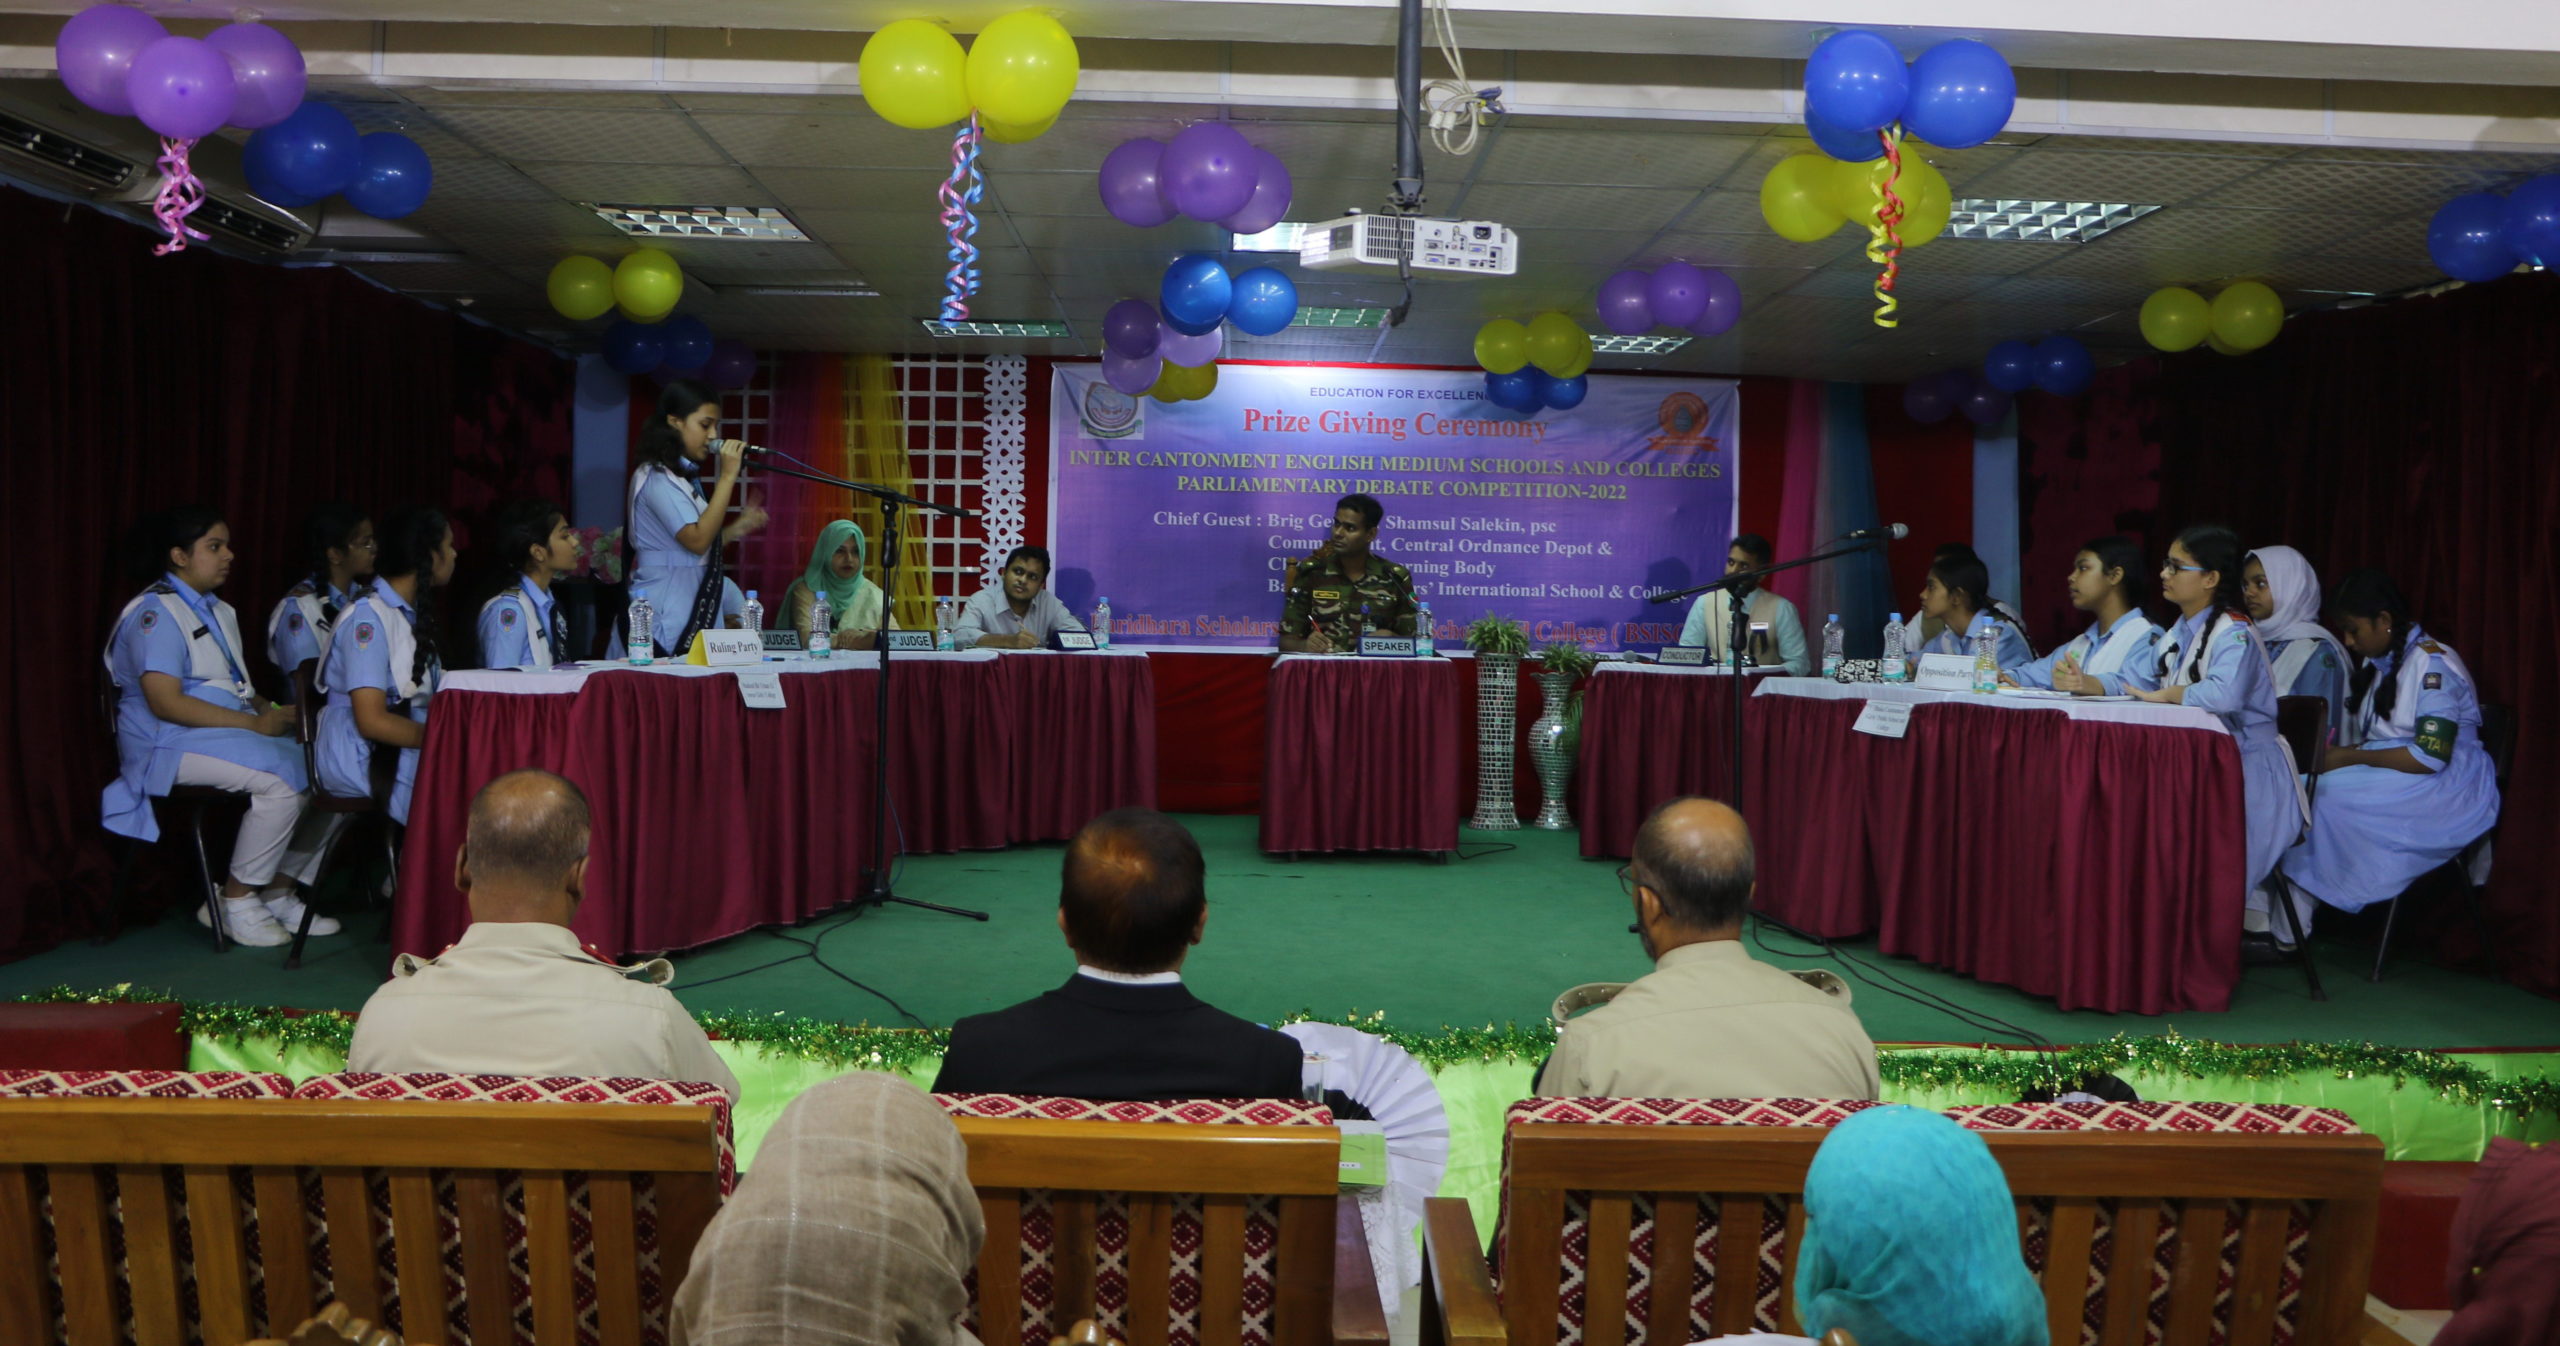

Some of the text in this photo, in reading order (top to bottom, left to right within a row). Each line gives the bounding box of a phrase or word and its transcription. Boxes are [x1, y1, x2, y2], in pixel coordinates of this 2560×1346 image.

[1310, 387, 1488, 400] EDUCATION FOR EXCELLEN
[1243, 408, 1549, 444] Prize Giving Ceremony
[1069, 450, 1721, 478] INTER CANTONMENT ENGLISH MEDIUM SCHOOLS AND COLLEGES
[1177, 475, 1627, 499] PARLIAMENTARY DEBATE COMPETITION-2022
[1153, 511, 1200, 526] Chief
[1203, 512, 1251, 526] Guest
[1256, 515, 1262, 527] :
[1268, 513, 1304, 530] Brig
[1385, 515, 1456, 531] Shamsul
[1460, 517, 1526, 534] Salekin,
[1530, 520, 1557, 536] psc
[1391, 537, 1454, 552] Central
[1458, 539, 1539, 554] Ordnance
[1545, 541, 1593, 558] Depot
[1597, 542, 1613, 555] &
[1454, 560, 1496, 578] Body
[1438, 582, 1545, 598] International
[1550, 584, 1604, 599] School
[1608, 584, 1624, 599] &
[764, 633, 797, 646] JUDGE
[899, 635, 930, 647] JUDGE
[1535, 621, 1607, 648] College
[709, 640, 758, 655] Ruling Party
[1364, 640, 1412, 651] SPEAKER
[1661, 649, 1702, 661] CONDUCTOR
[1920, 666, 1957, 679] Opposition
